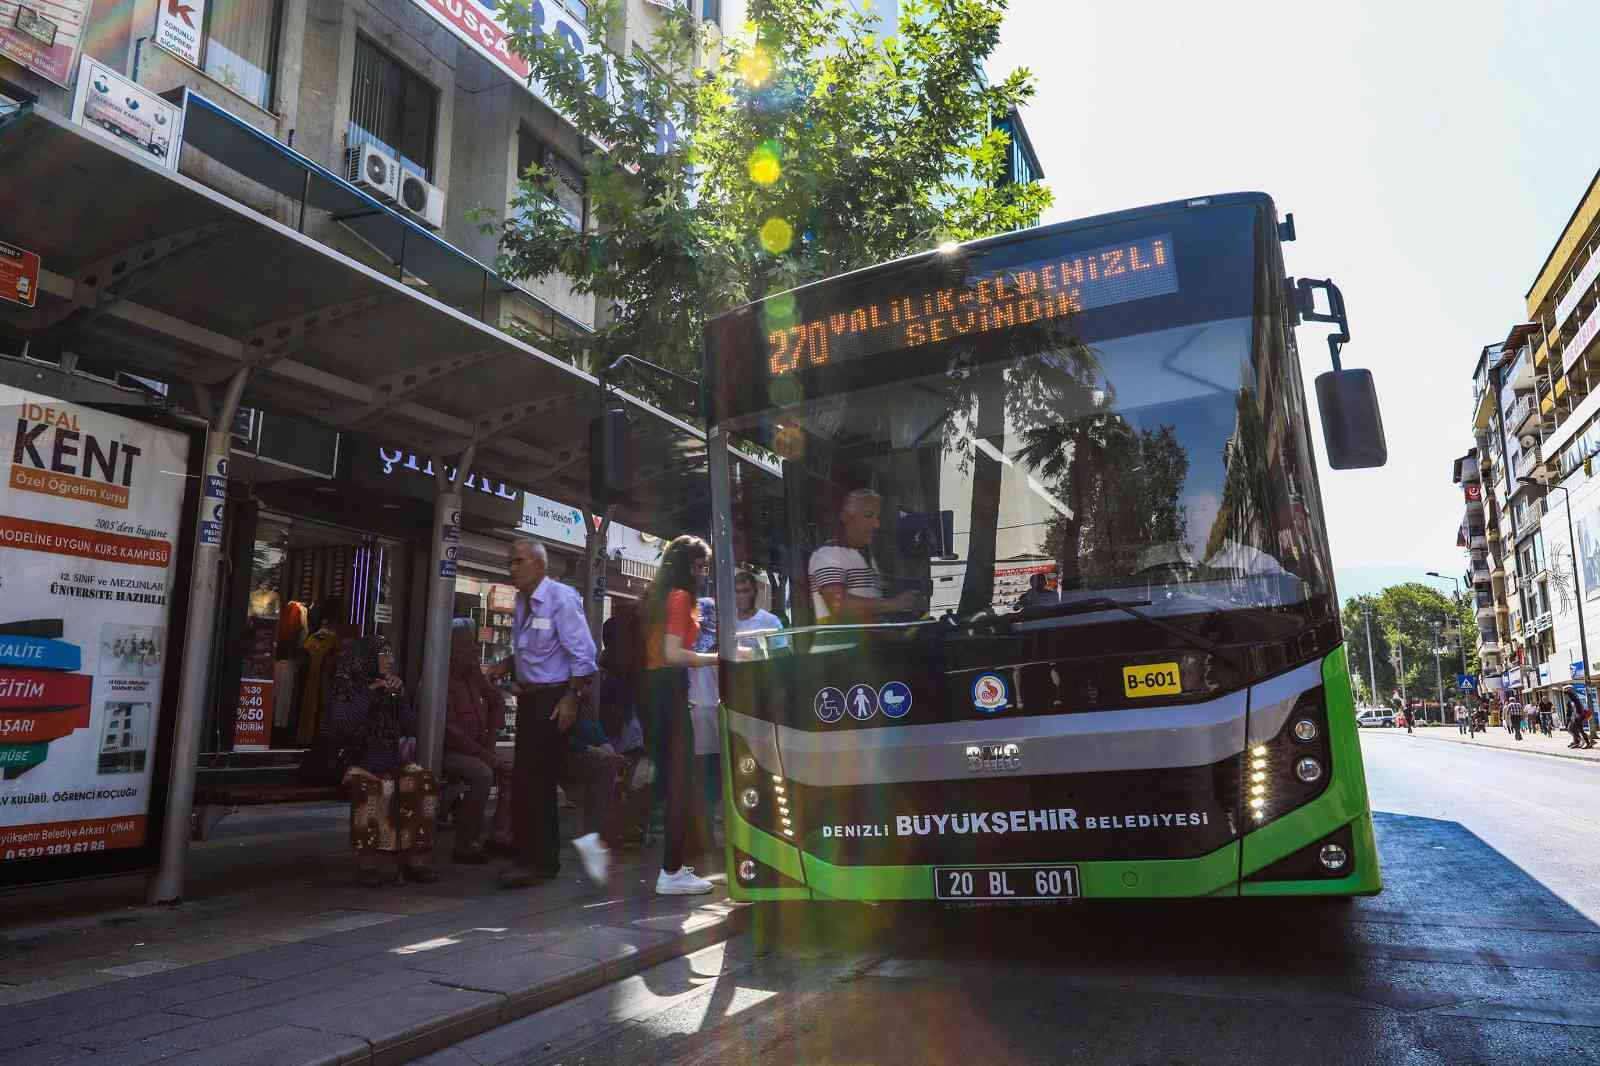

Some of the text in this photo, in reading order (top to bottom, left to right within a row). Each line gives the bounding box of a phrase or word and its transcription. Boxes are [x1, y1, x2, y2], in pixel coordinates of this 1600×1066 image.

[163, 18, 196, 42] ZORUNLU
[904, 287, 1082, 347] SEVİNDİK
[769, 320, 829, 375] 270
[22, 398, 81, 432] İDEAL
[13, 418, 142, 487] KENT
[16, 471, 127, 504] Özel Öğretim Kursu
[537, 506, 573, 525] Türk Telekom
[95, 544, 118, 555] KURS
[120, 546, 168, 562] KAMPÜSÜ
[97, 578, 108, 586] ve
[1127, 671, 1177, 689] B-601
[244, 686, 262, 694] %30
[240, 695, 263, 706] %40
[236, 708, 264, 720] %50
[52, 790, 95, 802] ÖĞRENCİ
[97, 786, 137, 801] KOÇLUĞU
[896, 808, 1079, 836] BÜYÜKŞEHİR
[42, 827, 77, 842] Belediye
[949, 869, 1074, 896] 20 BL 601
